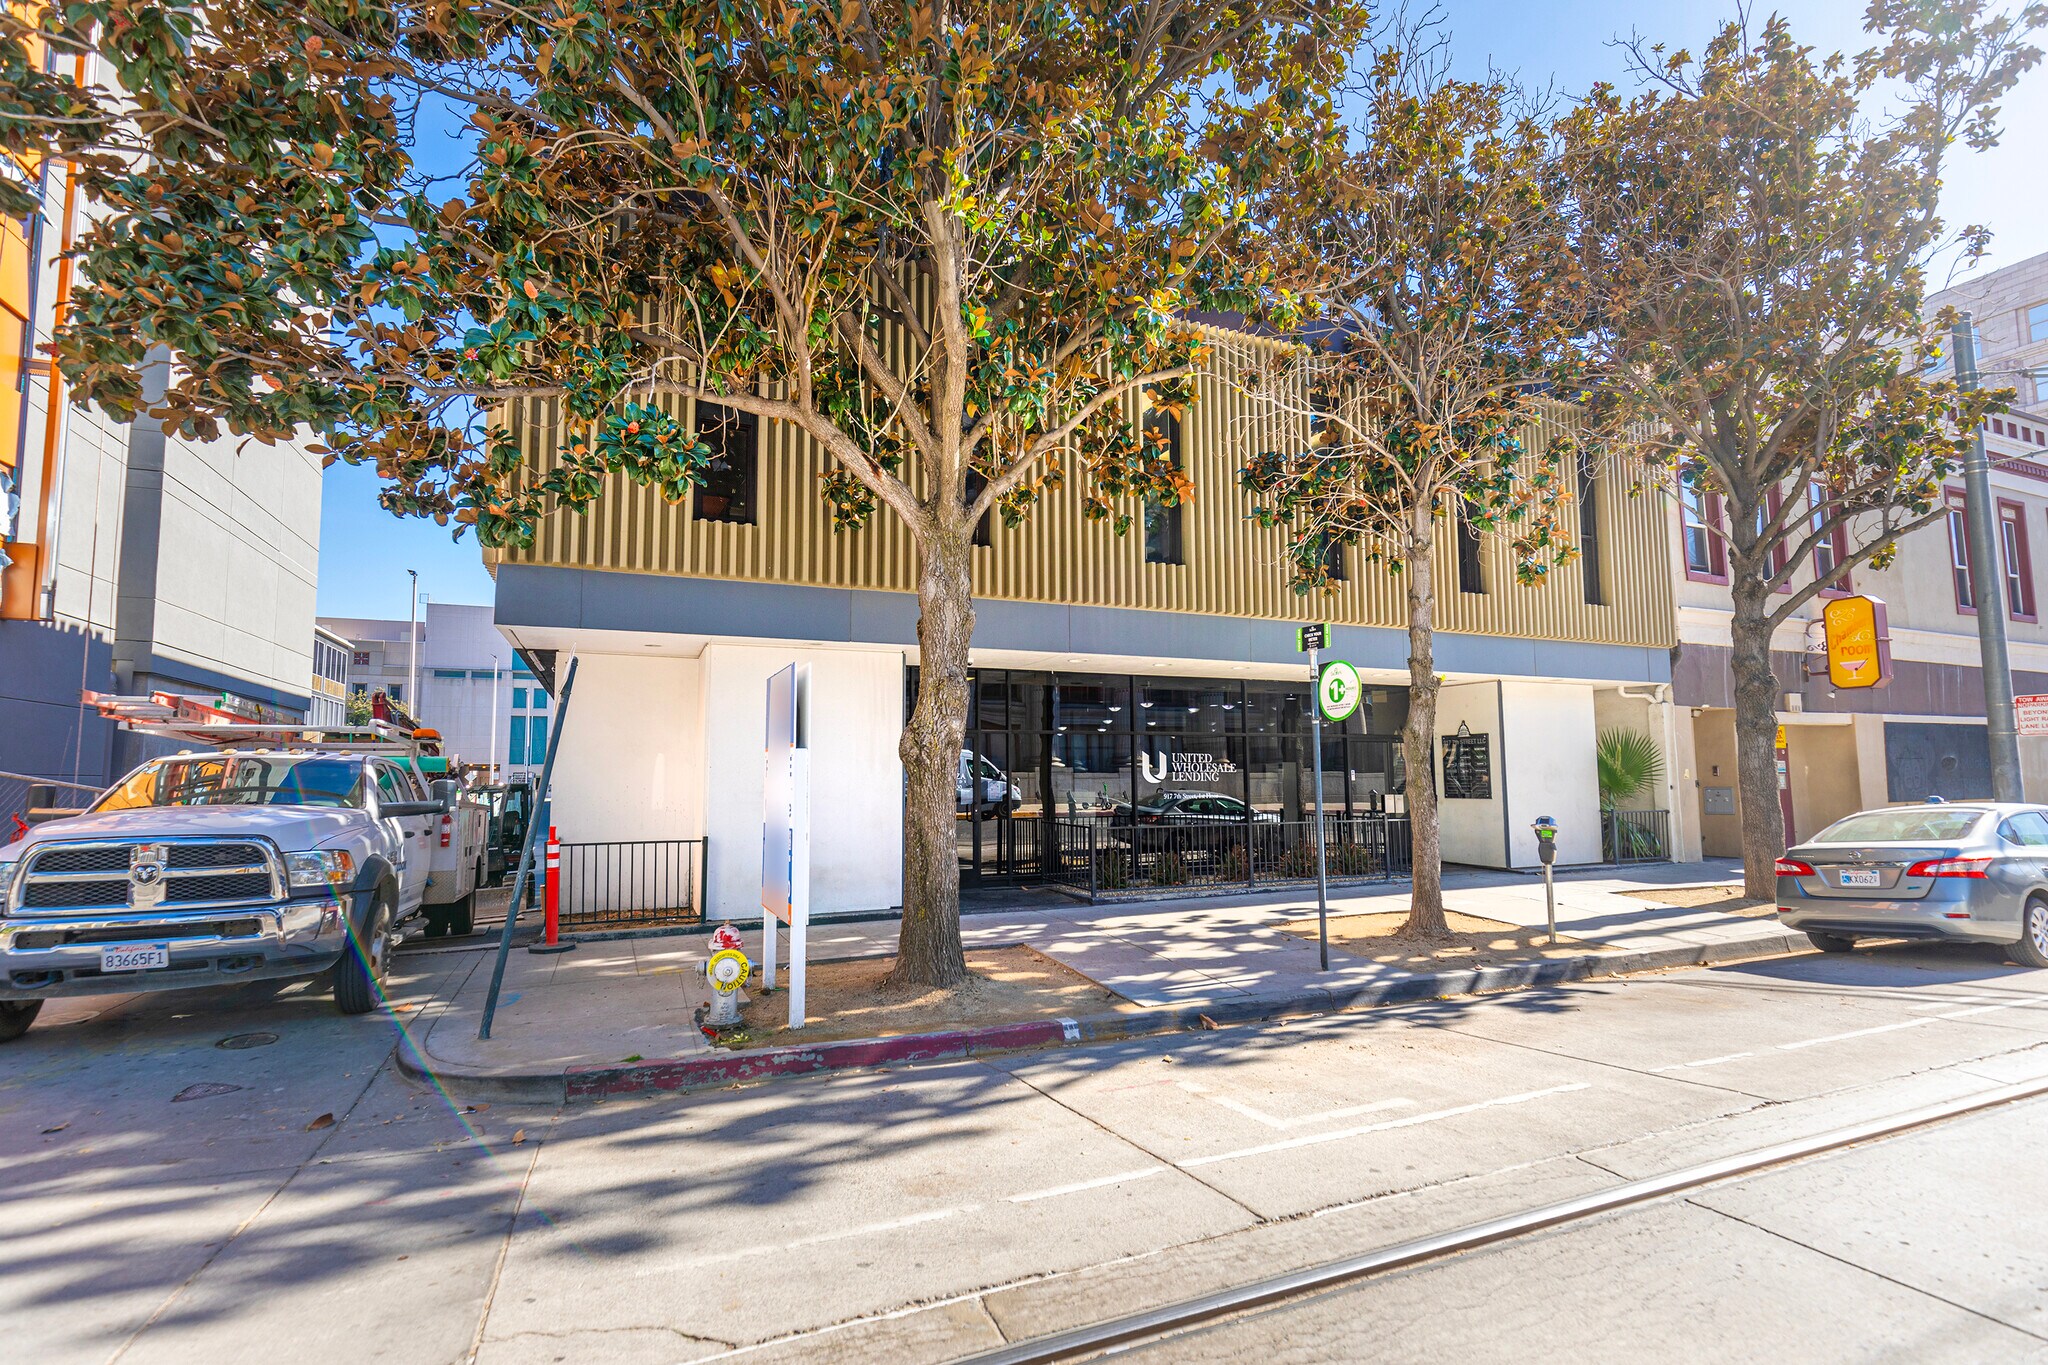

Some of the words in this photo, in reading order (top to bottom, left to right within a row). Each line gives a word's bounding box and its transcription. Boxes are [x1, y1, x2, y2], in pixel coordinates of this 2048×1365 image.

[1841, 645, 1872, 656] room
[1172, 752, 1213, 763] UNITED
[1172, 762, 1237, 773] WHOLESALE
[1172, 772, 1220, 782] LENDING
[105, 952, 164, 968] 83665F1
